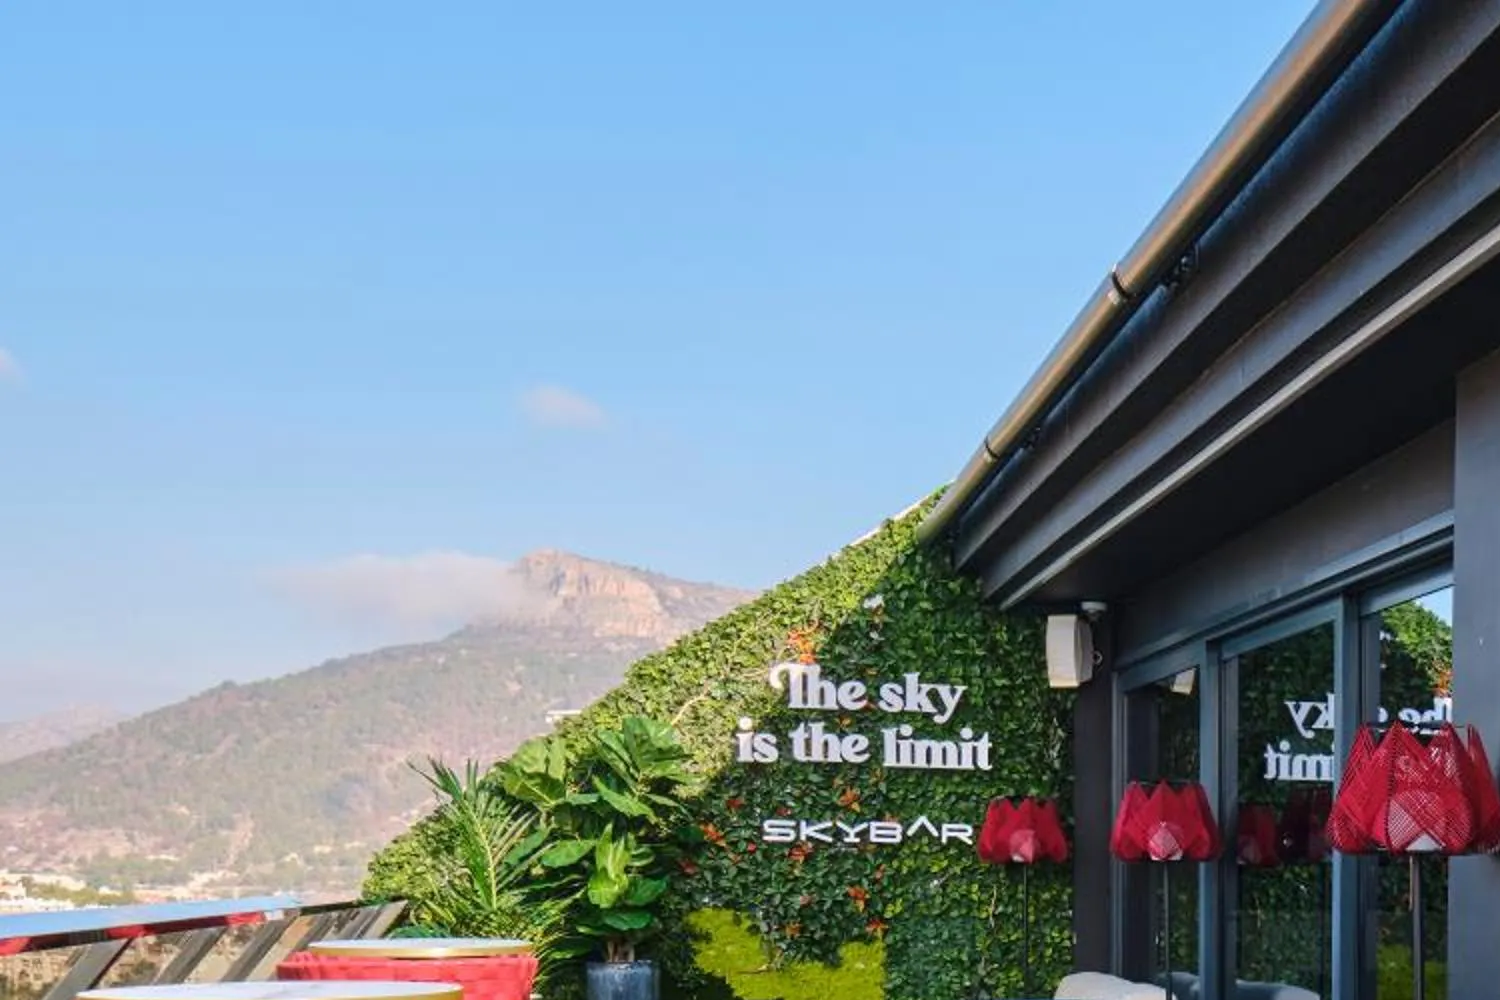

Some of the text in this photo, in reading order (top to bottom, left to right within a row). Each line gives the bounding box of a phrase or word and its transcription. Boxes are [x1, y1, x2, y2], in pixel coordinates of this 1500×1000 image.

[769, 663, 967, 723] The sky
[736, 717, 993, 770] is the limit
[762, 815, 973, 844] SKYBAR
